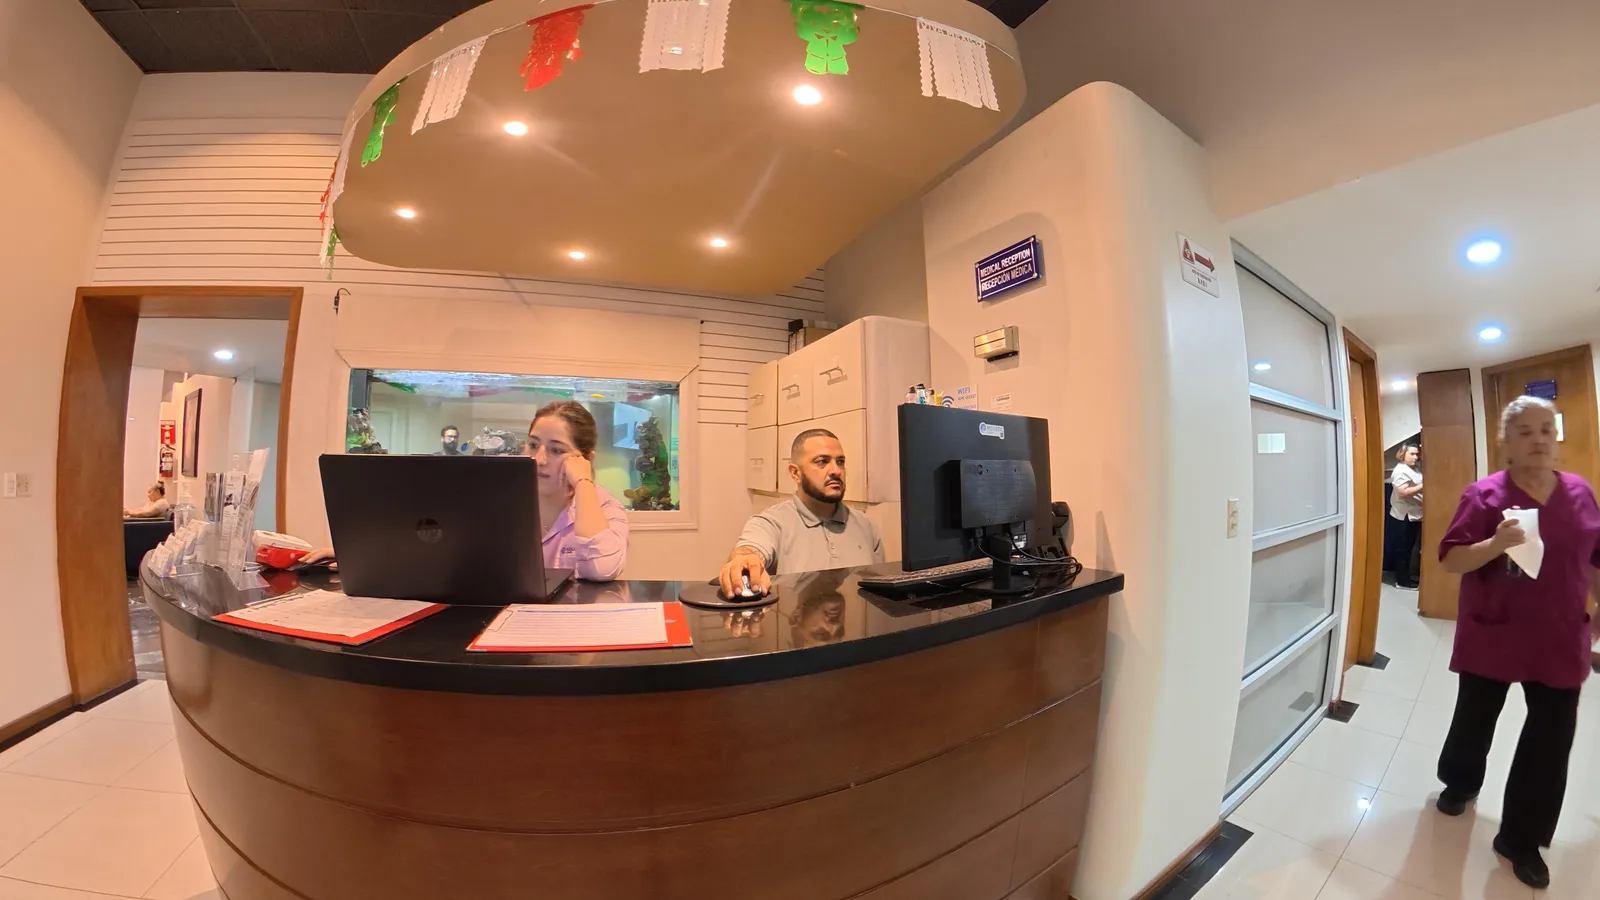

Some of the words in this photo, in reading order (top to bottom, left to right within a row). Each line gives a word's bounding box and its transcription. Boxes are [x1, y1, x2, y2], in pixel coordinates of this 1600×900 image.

[980, 262, 1002, 278] MEDICAL
[1001, 248, 1031, 268] RECEPTION
[981, 271, 1011, 292] RECEPCIÓN
[1010, 263, 1032, 279] MÉDICA
[957, 386, 971, 395] WIFI
